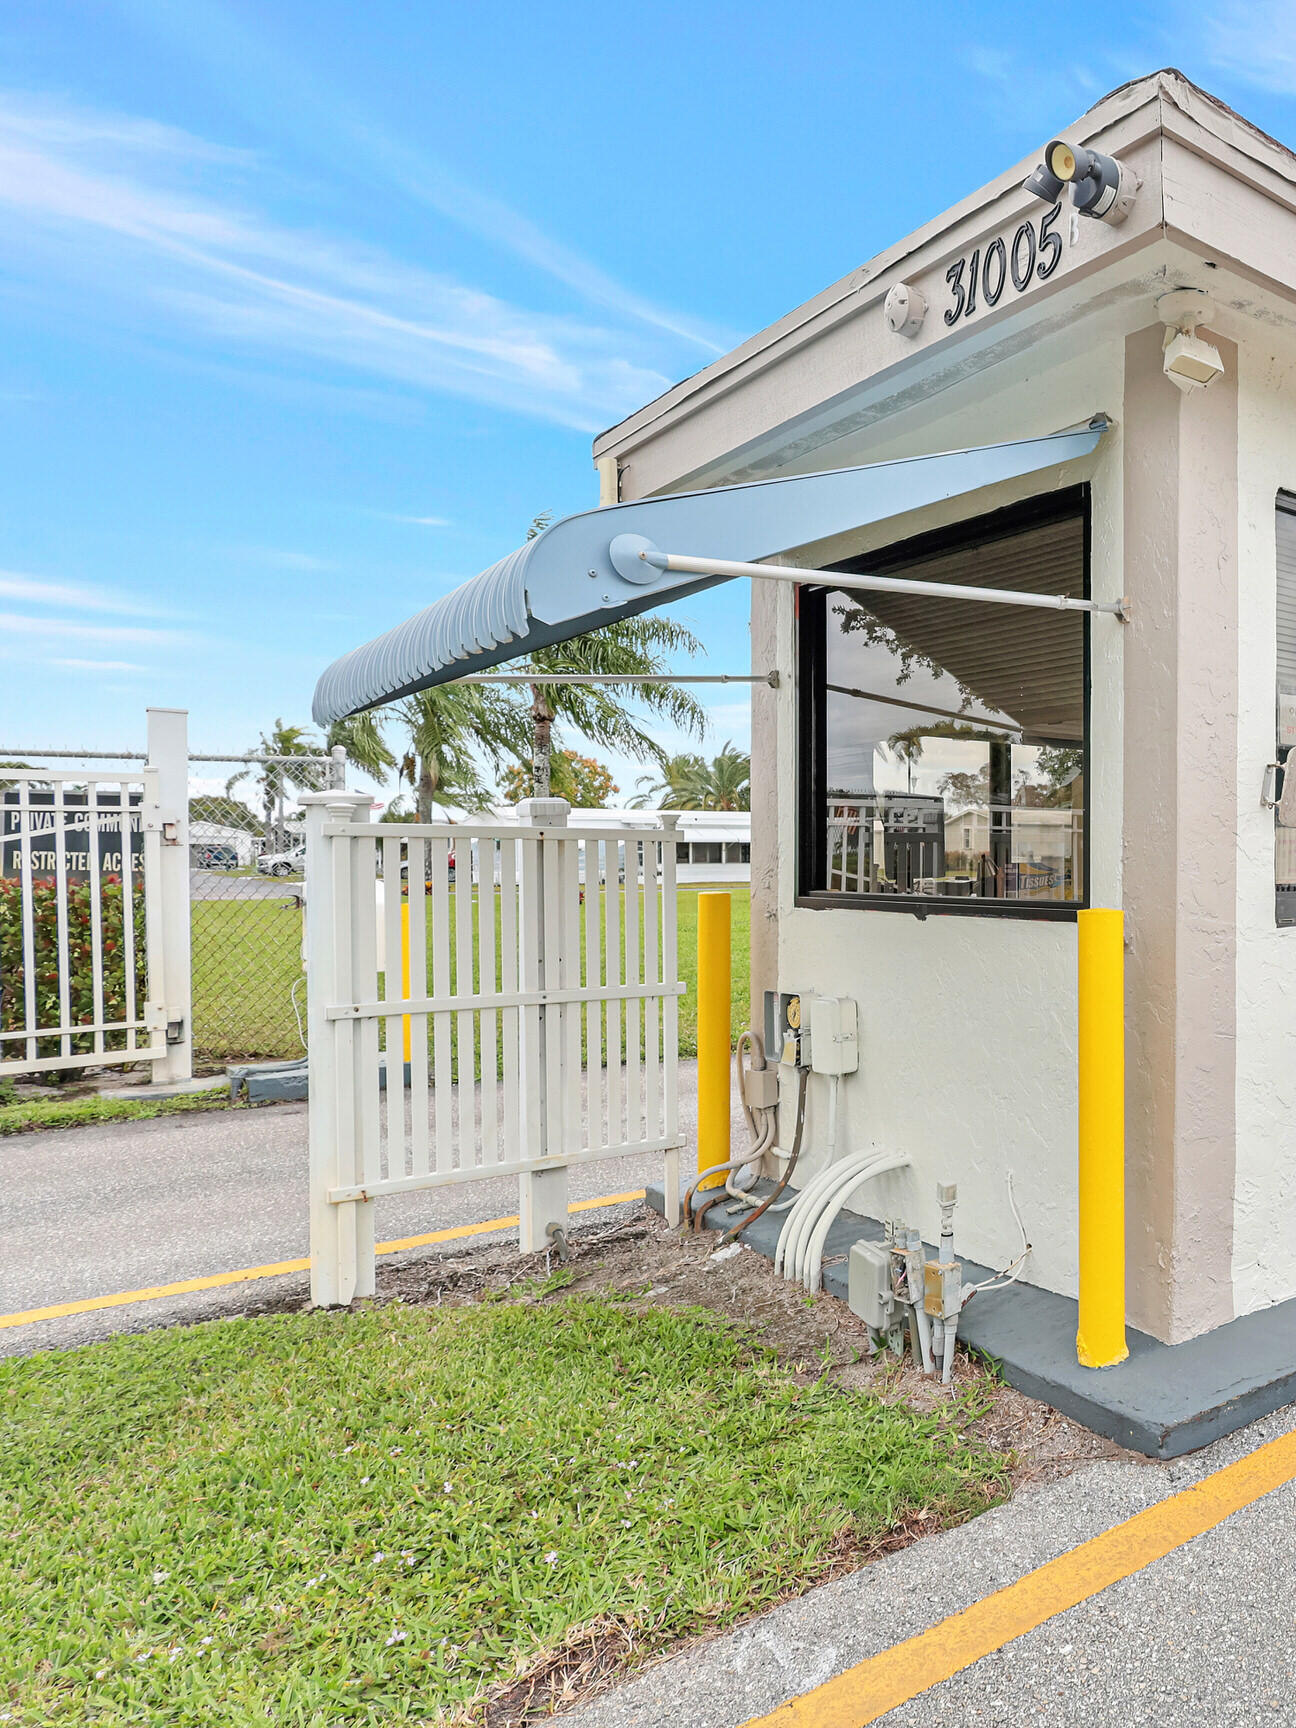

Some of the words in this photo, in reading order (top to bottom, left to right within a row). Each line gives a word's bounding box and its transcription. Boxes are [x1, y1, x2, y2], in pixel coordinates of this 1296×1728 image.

[944, 201, 1063, 326] 31005
[11, 811, 68, 831] PIVA
[12, 851, 92, 871] RSTRCTE
[102, 852, 145, 872] ACES
